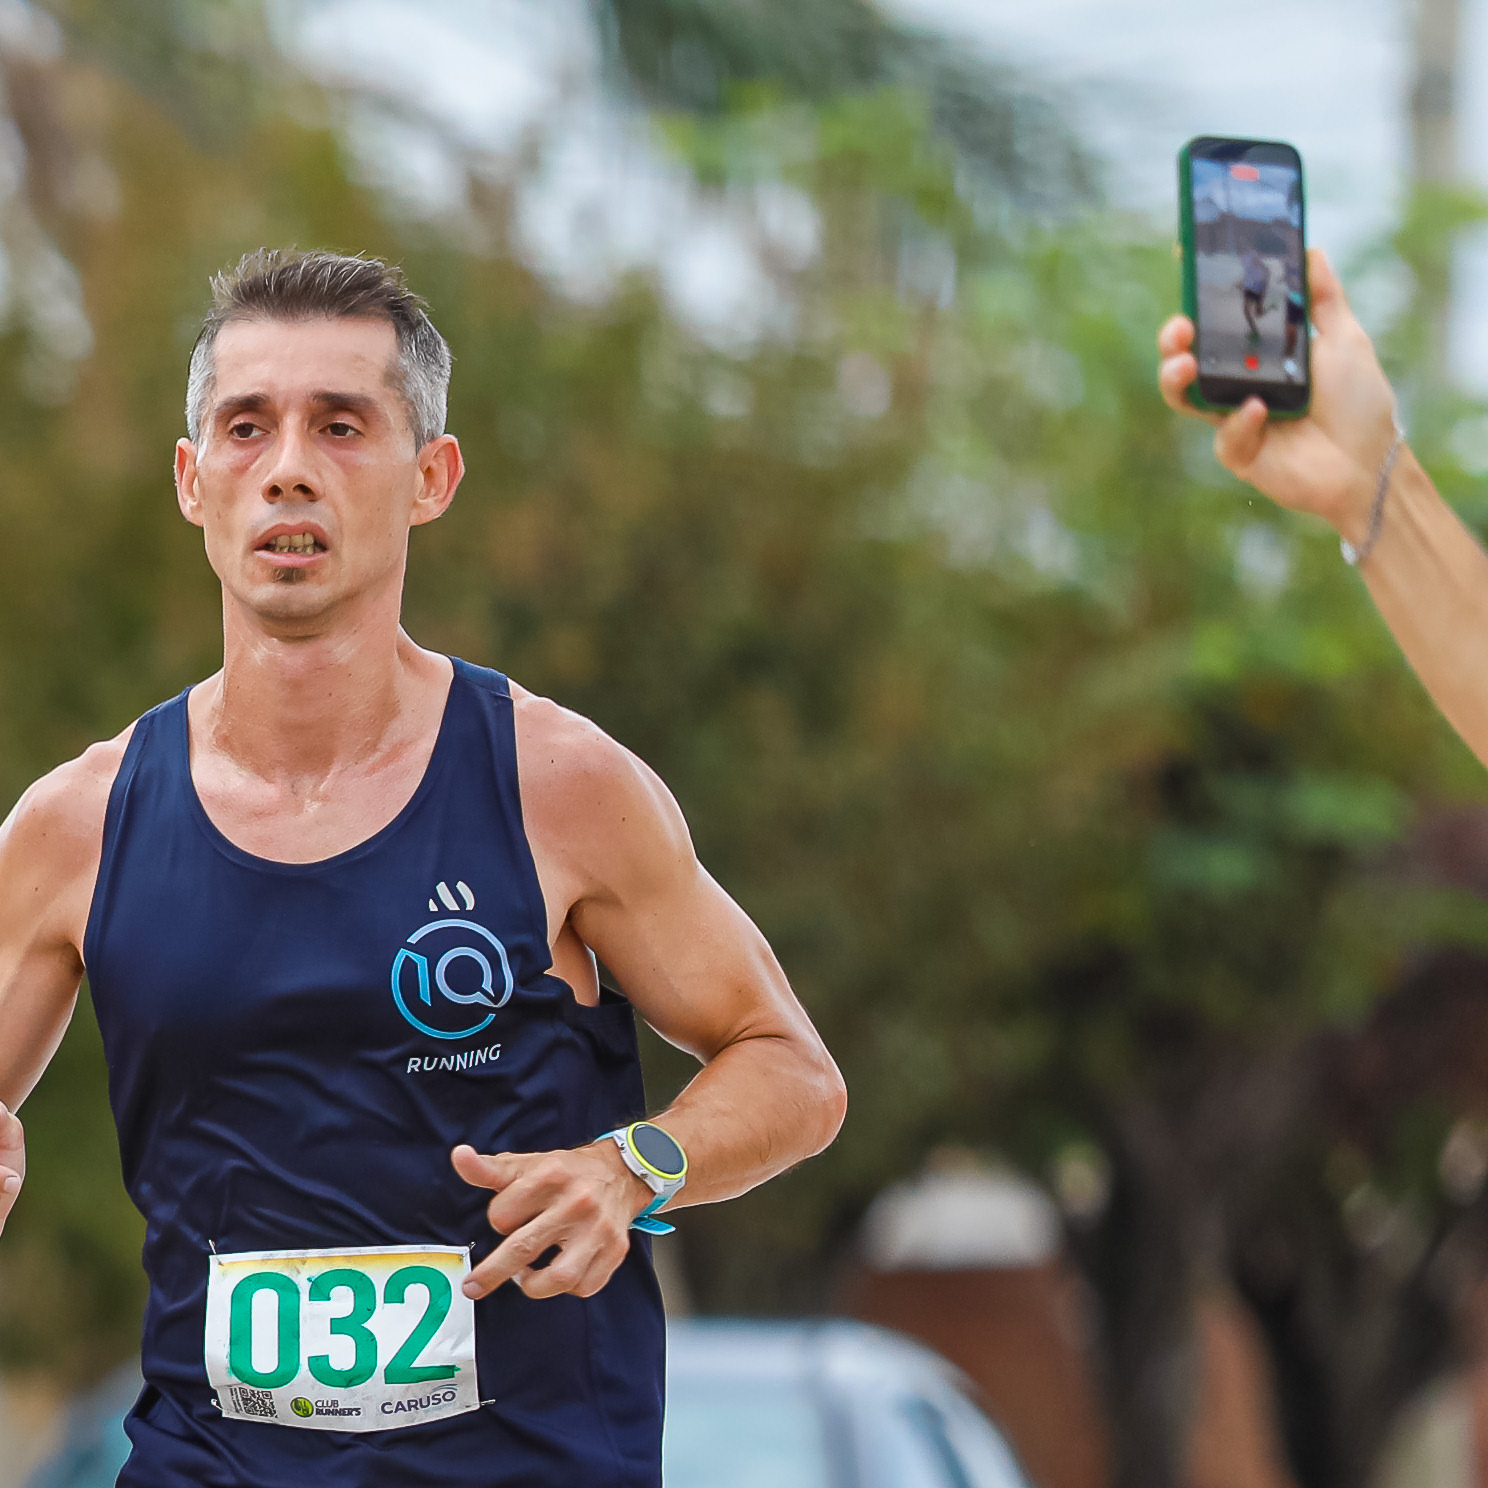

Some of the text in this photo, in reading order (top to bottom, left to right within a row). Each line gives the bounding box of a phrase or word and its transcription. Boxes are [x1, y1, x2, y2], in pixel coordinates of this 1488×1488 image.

[407, 1043, 502, 1074] RUNNING
[229, 1266, 458, 1388] 032
[315, 1400, 339, 1408] CLUB
[381, 1391, 456, 1414] CARUSO
